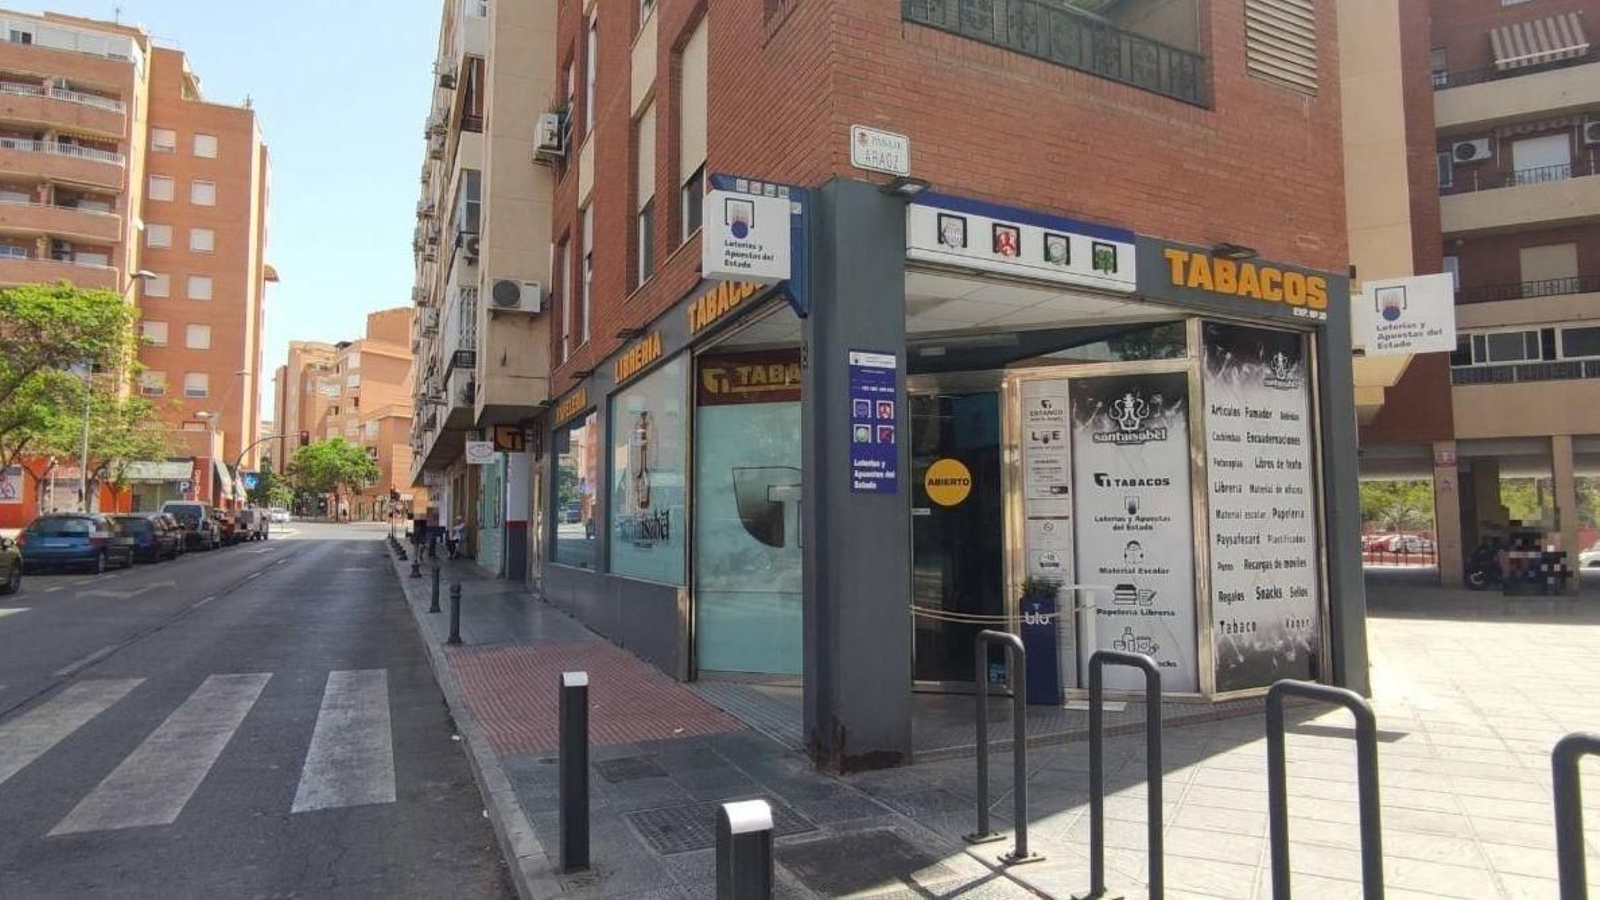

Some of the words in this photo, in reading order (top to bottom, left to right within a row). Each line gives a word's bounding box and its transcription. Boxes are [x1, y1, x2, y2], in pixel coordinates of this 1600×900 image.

[724, 250, 760, 260] Apuestas
[762, 253, 774, 262] del
[724, 260, 752, 269] Estado
[1164, 249, 1328, 308] TABACOS
[1377, 331, 1424, 341] Apuestas
[1426, 328, 1443, 337] del
[1377, 341, 1412, 349] Estado
[1245, 406, 1273, 419] Fumador
[1254, 456, 1275, 469] Libros
[1276, 458, 1284, 469] de
[1285, 458, 1302, 469] texto
[927, 477, 970, 487] ABIERTO
[1114, 477, 1171, 487] TABACOS
[1249, 483, 1274, 494] Material
[1134, 515, 1171, 524] Apuestas
[1215, 508, 1243, 519] Material
[1244, 508, 1267, 519] escolar
[1216, 532, 1261, 548] Paysafecard
[1243, 558, 1273, 572] Recargas
[1274, 557, 1282, 569] de
[1099, 567, 1136, 575] Material
[1137, 567, 1170, 575] Escolar
[1218, 589, 1245, 605] Regalos
[1255, 585, 1283, 600] Snacks
[1219, 618, 1258, 635] Tabaco
